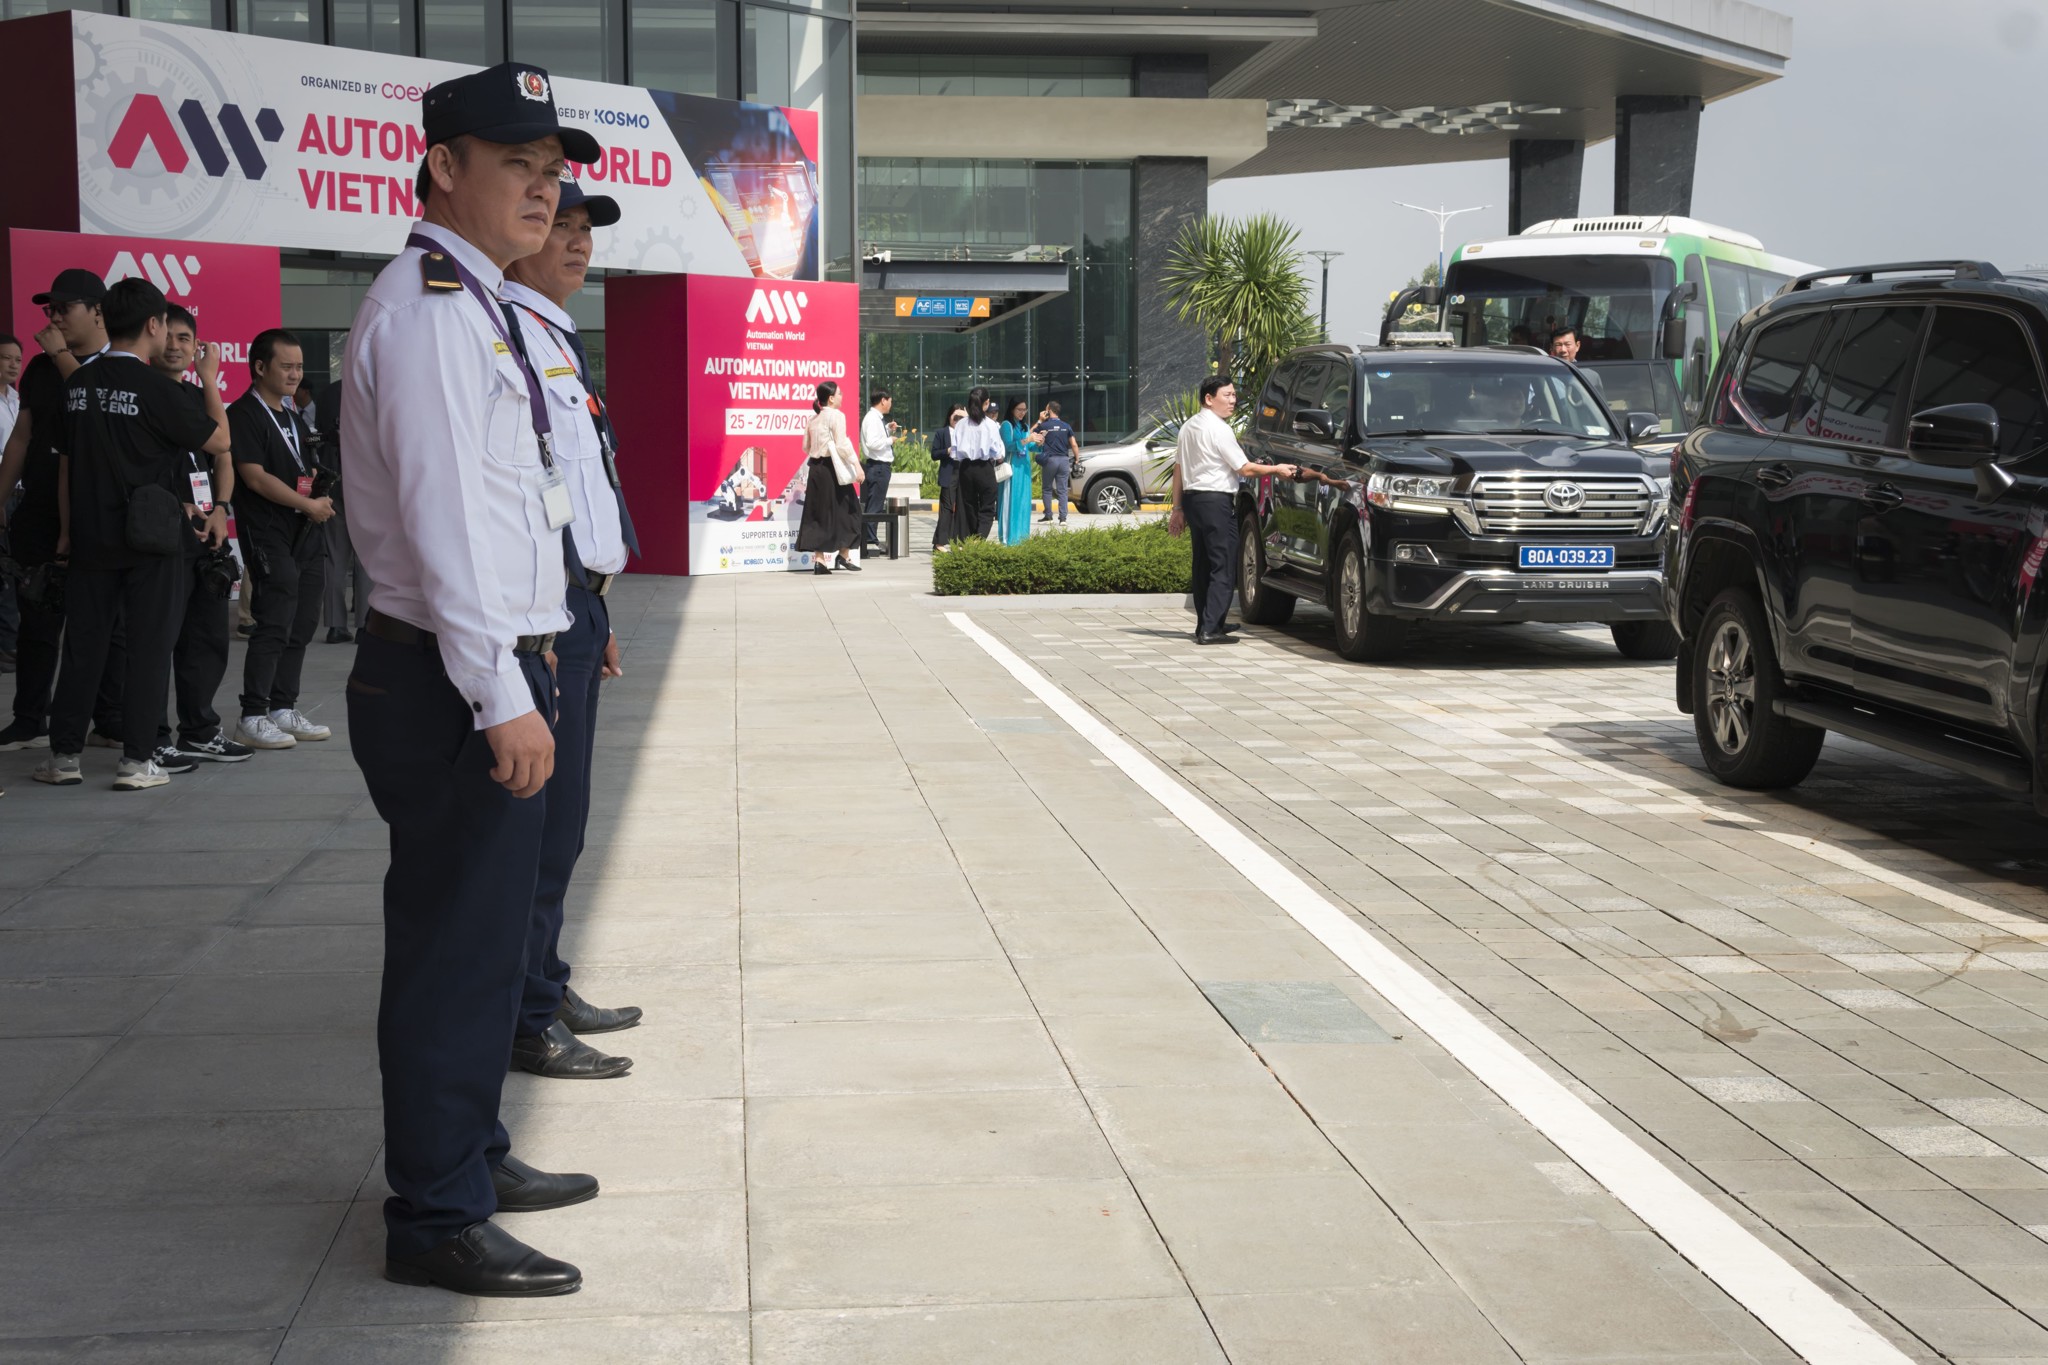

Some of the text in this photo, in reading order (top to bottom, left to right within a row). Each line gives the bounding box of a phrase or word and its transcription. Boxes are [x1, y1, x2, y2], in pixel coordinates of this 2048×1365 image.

[301, 75, 362, 93] ORGANIZED
[364, 83, 378, 95] BY
[578, 110, 591, 120] BY
[594, 109, 650, 129] KOSMO
[297, 113, 672, 187] AUTOM ORLD
[298, 168, 425, 218] VIETN
[746, 329, 805, 341] Automation World
[746, 341, 774, 351] VIETNAM
[704, 357, 845, 378] AUTOMATION WORLD
[69, 387, 138, 403] WHRE ART
[728, 382, 818, 401] VIETNAM 202
[67, 398, 88, 413] HAS
[109, 401, 139, 416] END
[730, 414, 745, 430] 25
[756, 413, 812, 431] 27/09/20
[741, 530, 800, 540] SUPPORTER & PART
[1522, 581, 1610, 589] LAND CRUISER
